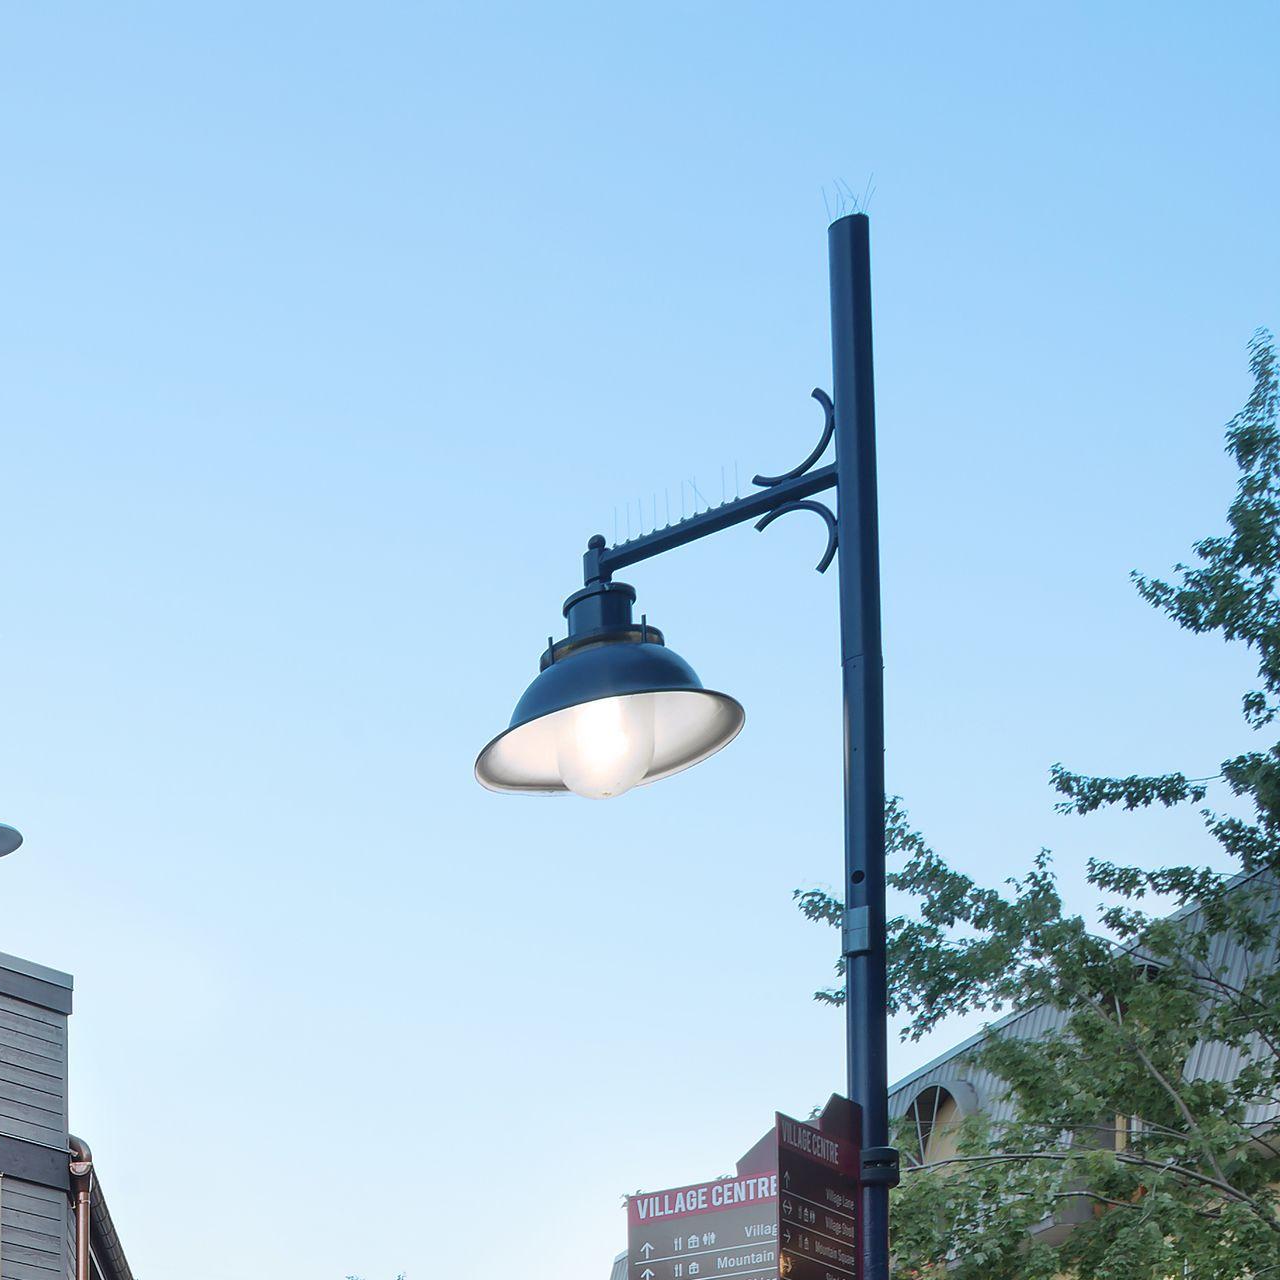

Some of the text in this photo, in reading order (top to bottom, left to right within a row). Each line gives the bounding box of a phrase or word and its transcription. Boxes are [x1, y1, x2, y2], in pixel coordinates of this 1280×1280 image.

[782, 1120, 839, 1165] VILLAGE CENTRE
[637, 1175, 778, 1219] VILLAGE CENTRE
[717, 1250, 775, 1269] Mountain
